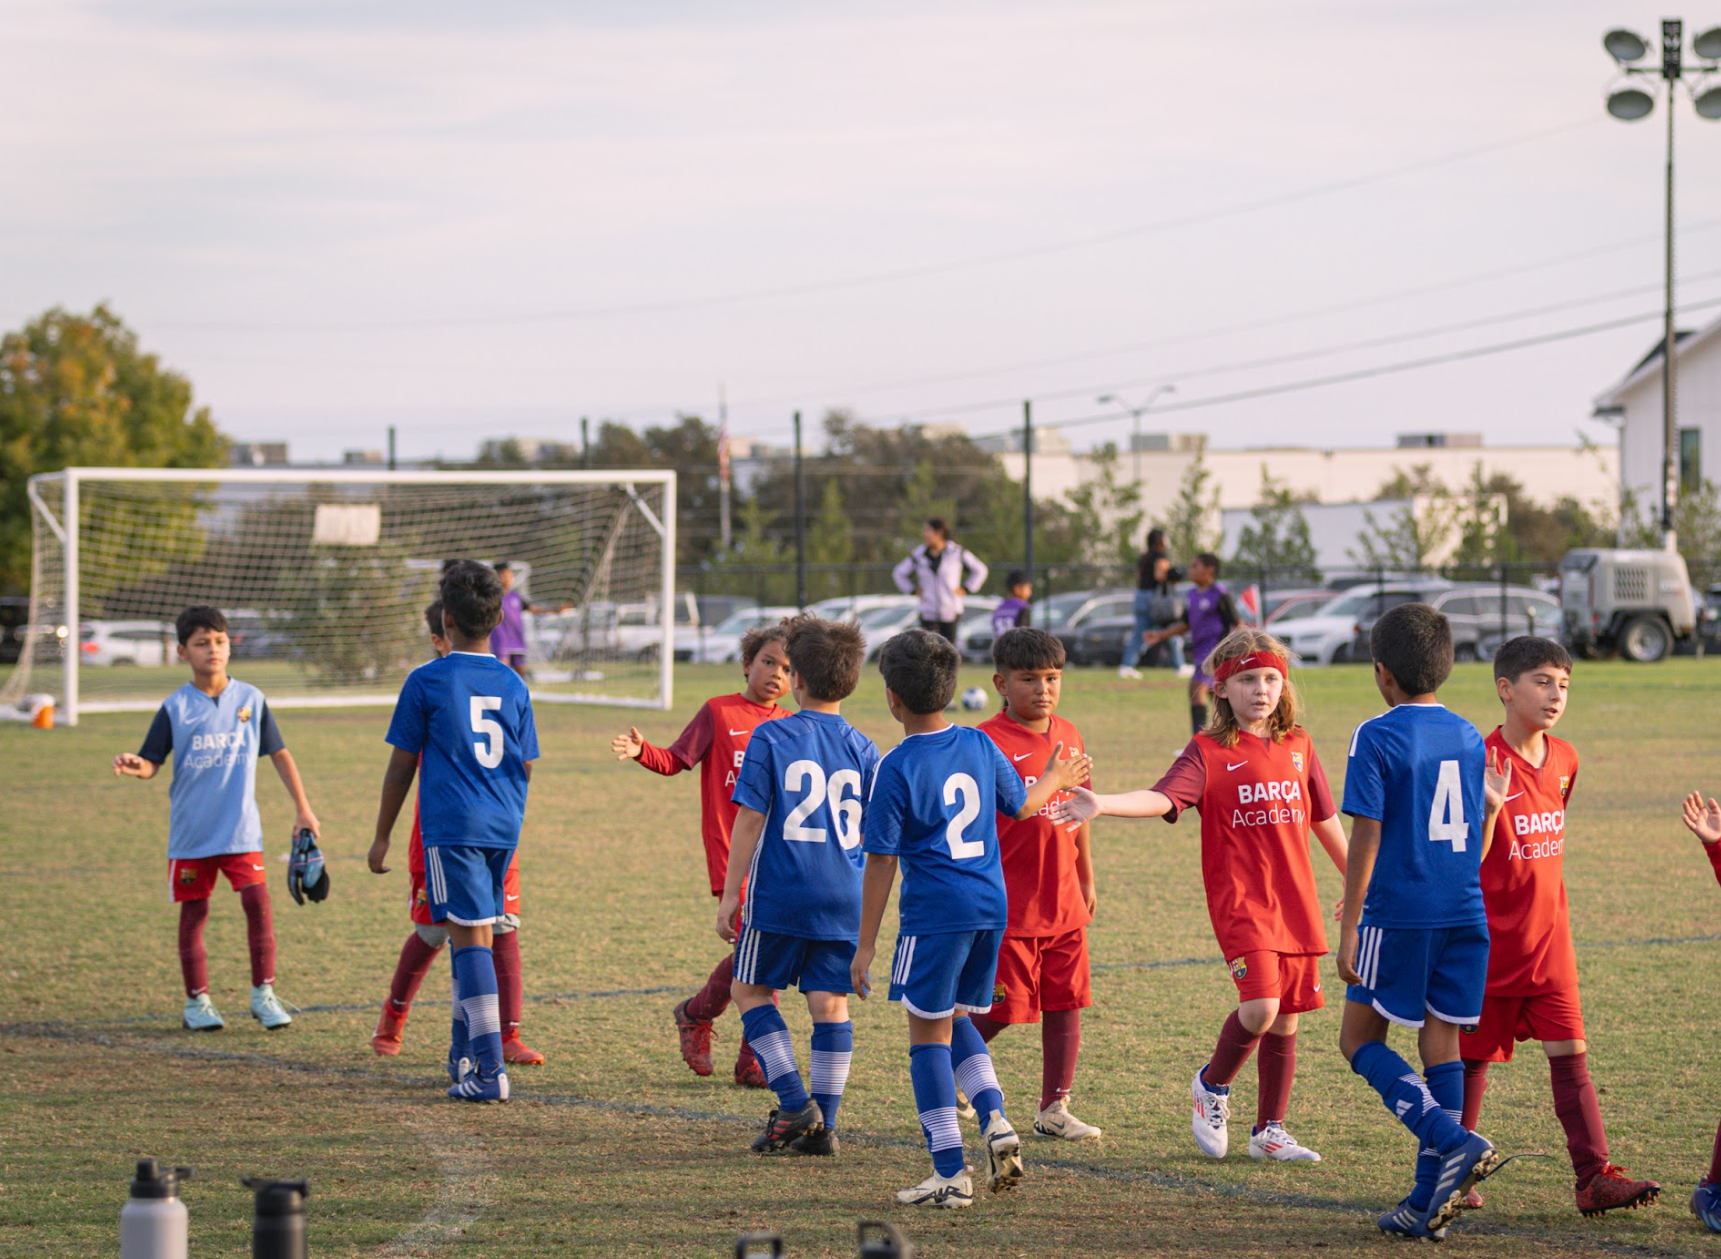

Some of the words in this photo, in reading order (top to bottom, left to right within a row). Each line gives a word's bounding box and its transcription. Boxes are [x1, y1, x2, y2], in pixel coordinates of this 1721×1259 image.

[470, 695, 504, 769] 5
[783, 759, 862, 850] 26
[943, 772, 984, 860] 2
[1238, 780, 1300, 804] BARÇA
[1428, 760, 1469, 853] 4
